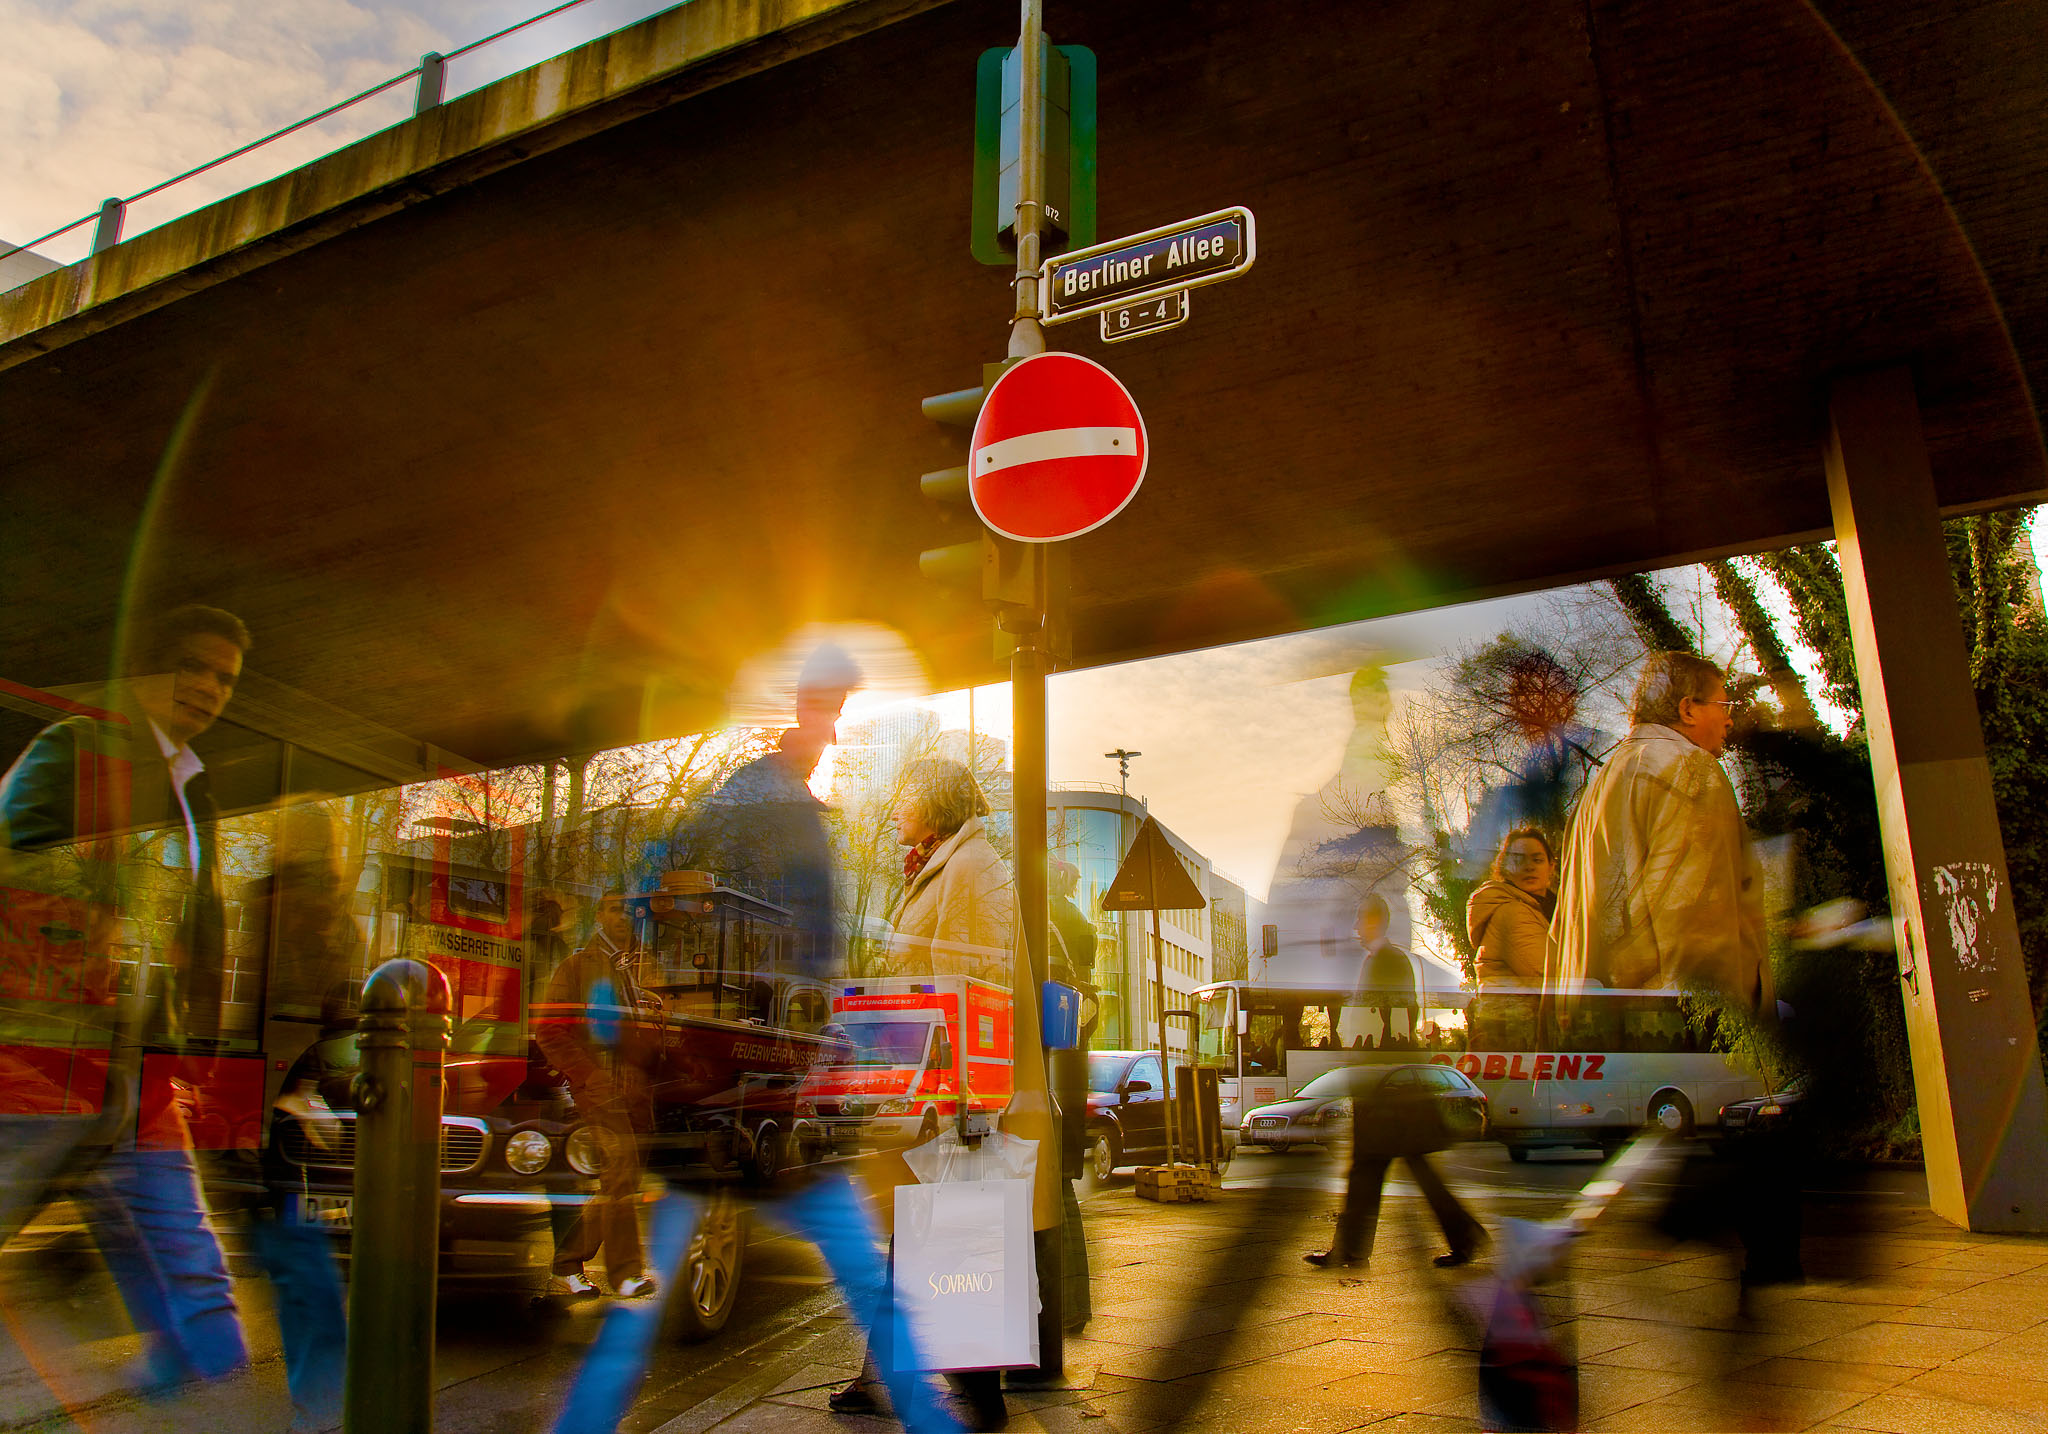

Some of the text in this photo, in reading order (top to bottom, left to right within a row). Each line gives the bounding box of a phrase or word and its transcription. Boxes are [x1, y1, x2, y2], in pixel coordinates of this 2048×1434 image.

[1045, 204, 1060, 222] 072
[1064, 235, 1224, 297] Berliner Allee
[1119, 310, 1130, 329] 6
[1155, 300, 1167, 319] 4
[428, 928, 522, 962] WASSERRETTUNG
[847, 998, 916, 1007] RETTUNGSDIENST
[731, 1041, 788, 1065] FEUERWEHR
[928, 1271, 993, 1301] SOVRANO
